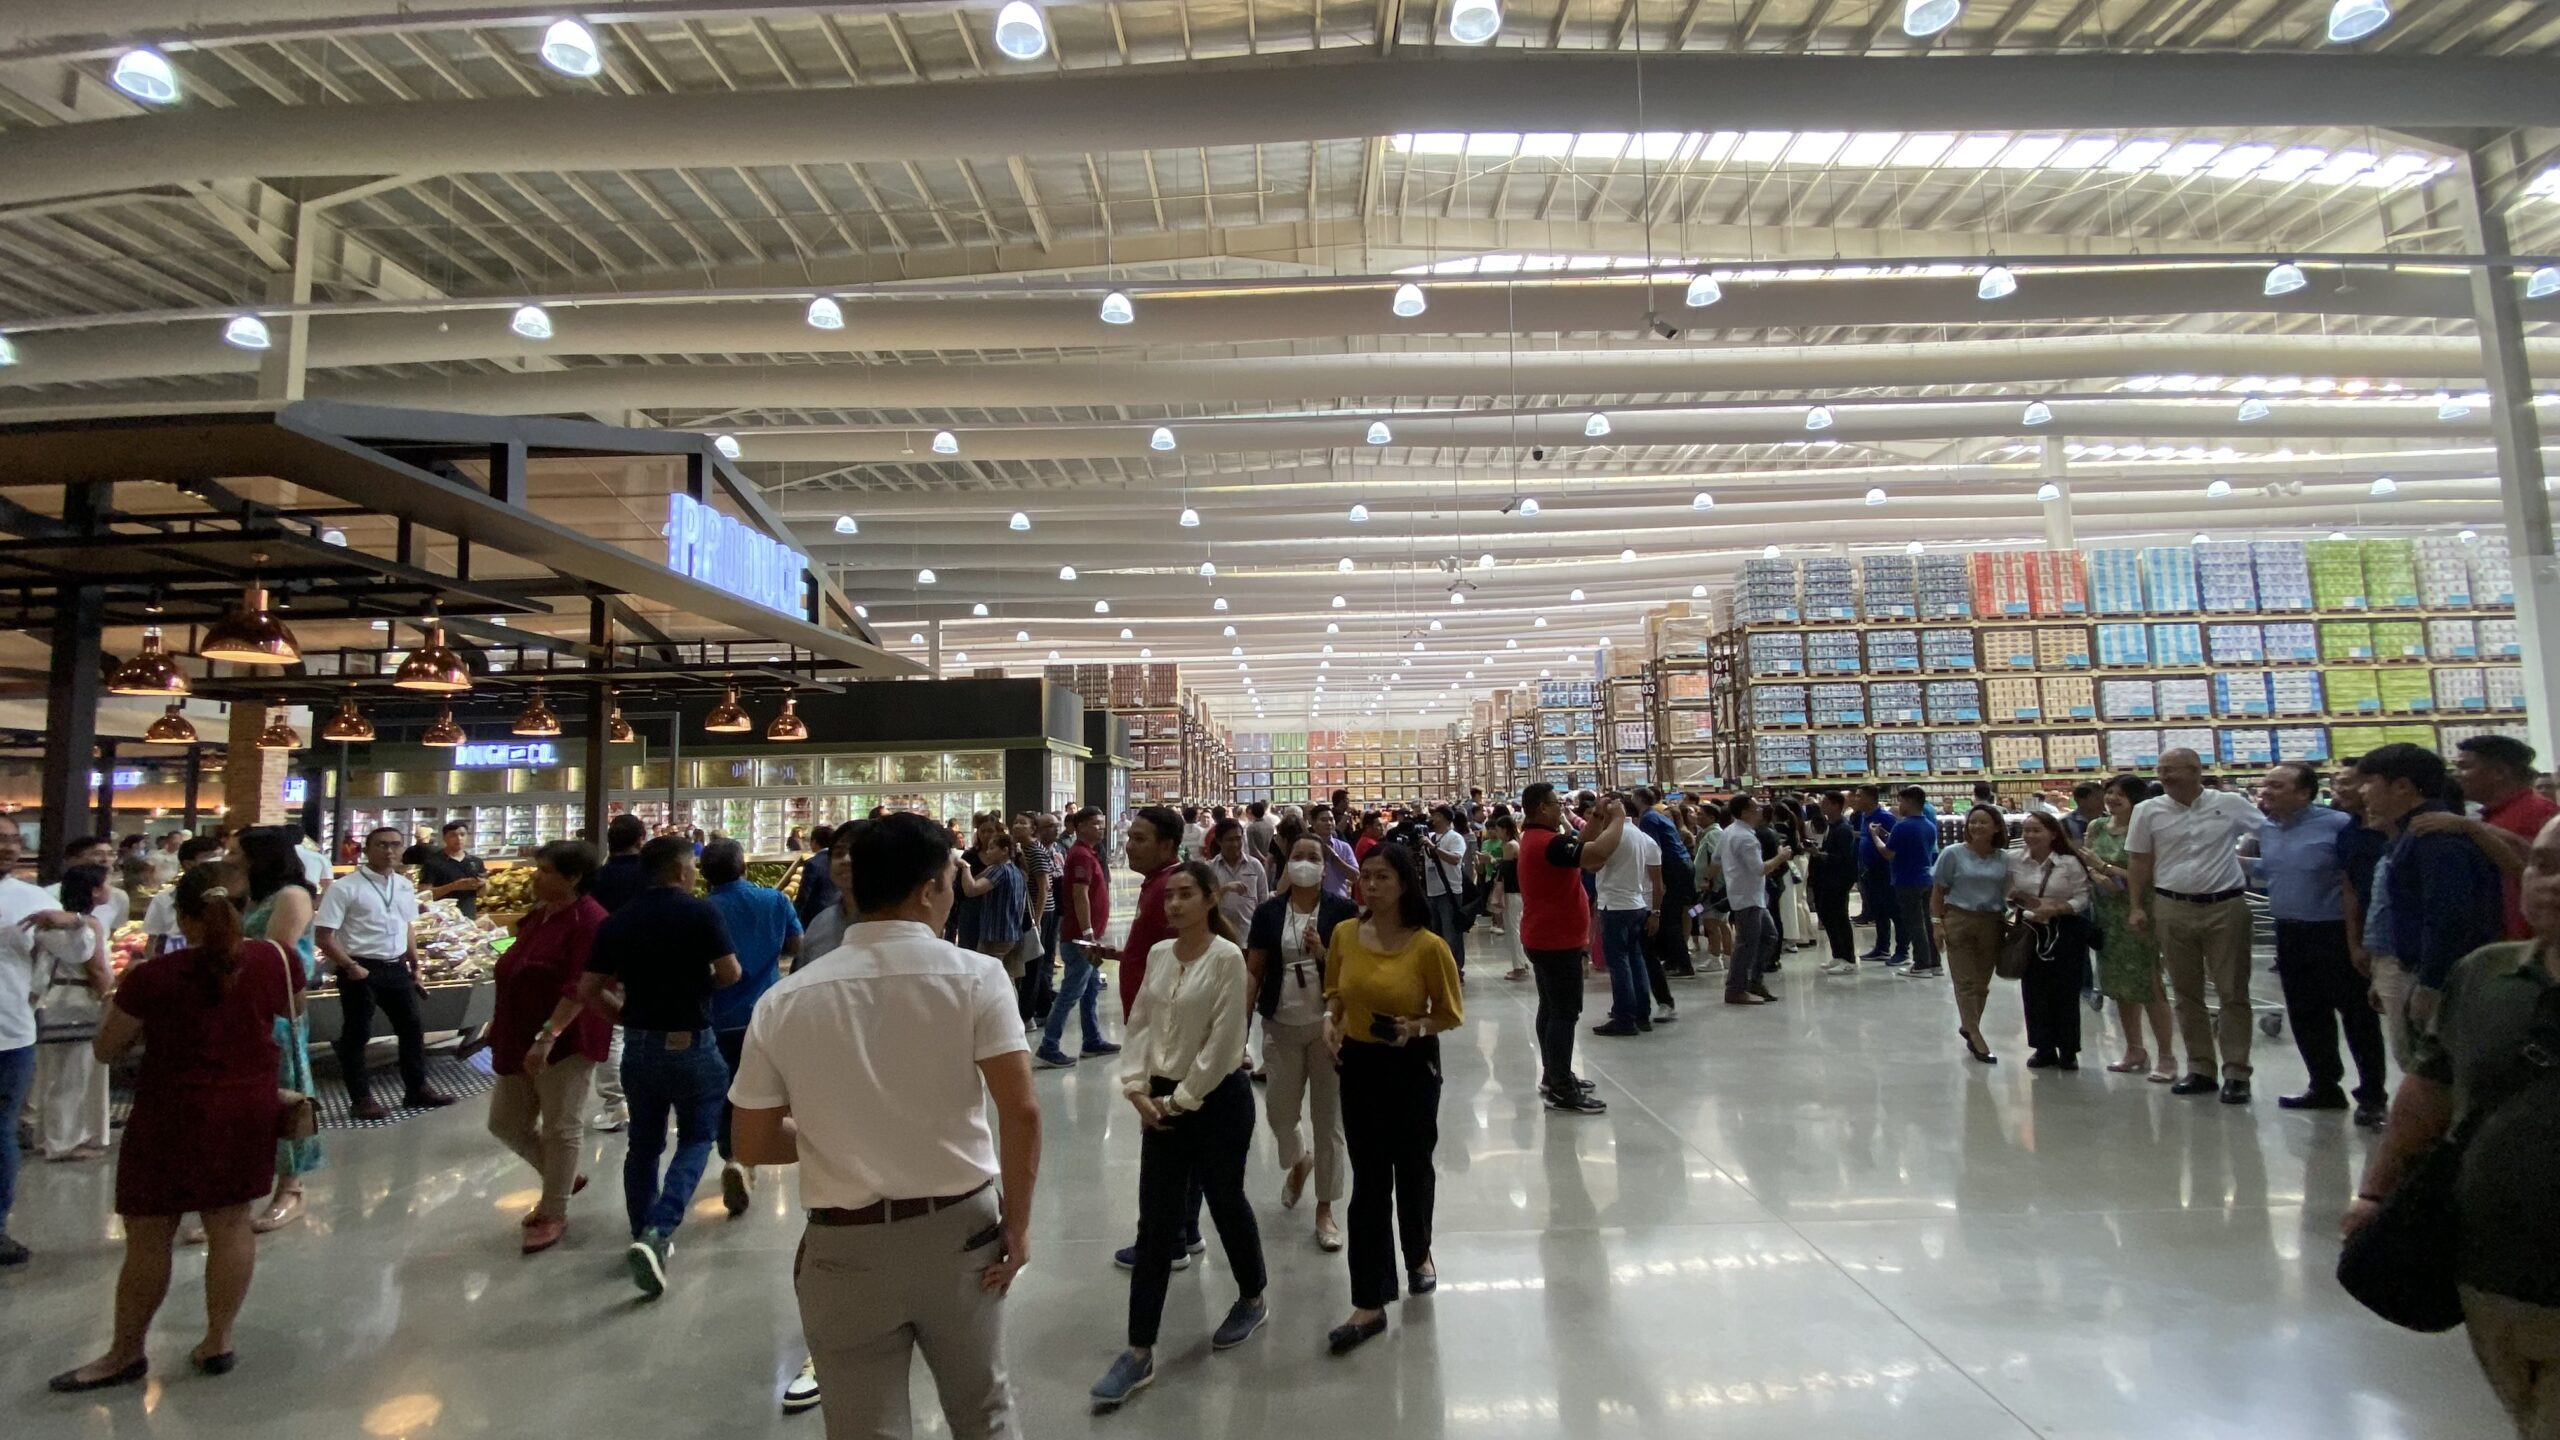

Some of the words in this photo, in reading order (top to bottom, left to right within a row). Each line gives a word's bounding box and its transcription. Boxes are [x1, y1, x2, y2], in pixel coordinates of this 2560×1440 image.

[669, 493, 809, 622] PRODUCE
[1713, 659, 1729, 671] 01
[1641, 684, 1656, 694] 03
[1592, 702, 1604, 711] 05
[1184, 724, 1193, 732] 21
[1195, 732, 1204, 740] 23
